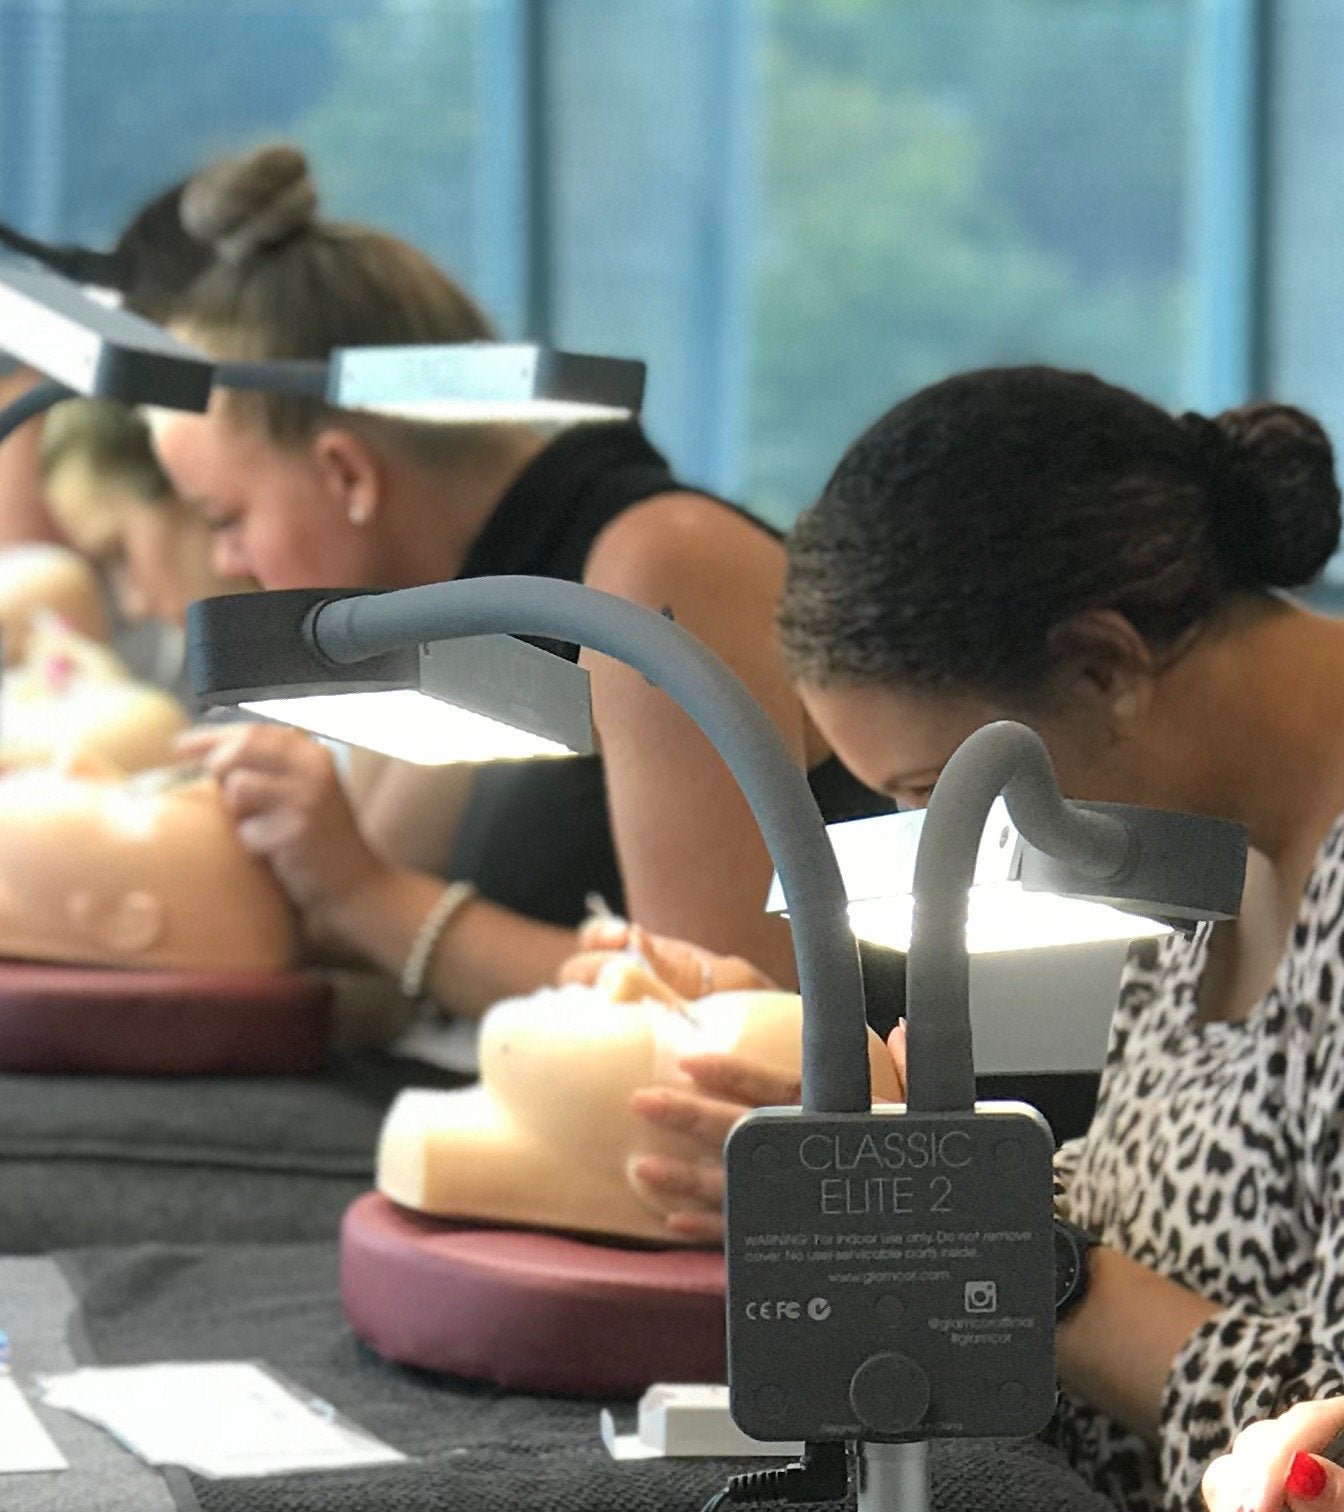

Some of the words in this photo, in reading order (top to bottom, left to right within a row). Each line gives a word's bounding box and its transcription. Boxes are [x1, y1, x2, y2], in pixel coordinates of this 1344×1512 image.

[798, 1131, 972, 1171] CLASSIC
[820, 1177, 913, 1214] ELITE
[930, 1176, 952, 1213] 2
[836, 1233, 878, 1245] indoor
[936, 1230, 955, 1244] Do
[958, 1230, 981, 1243] not
[982, 1230, 1033, 1243] remove
